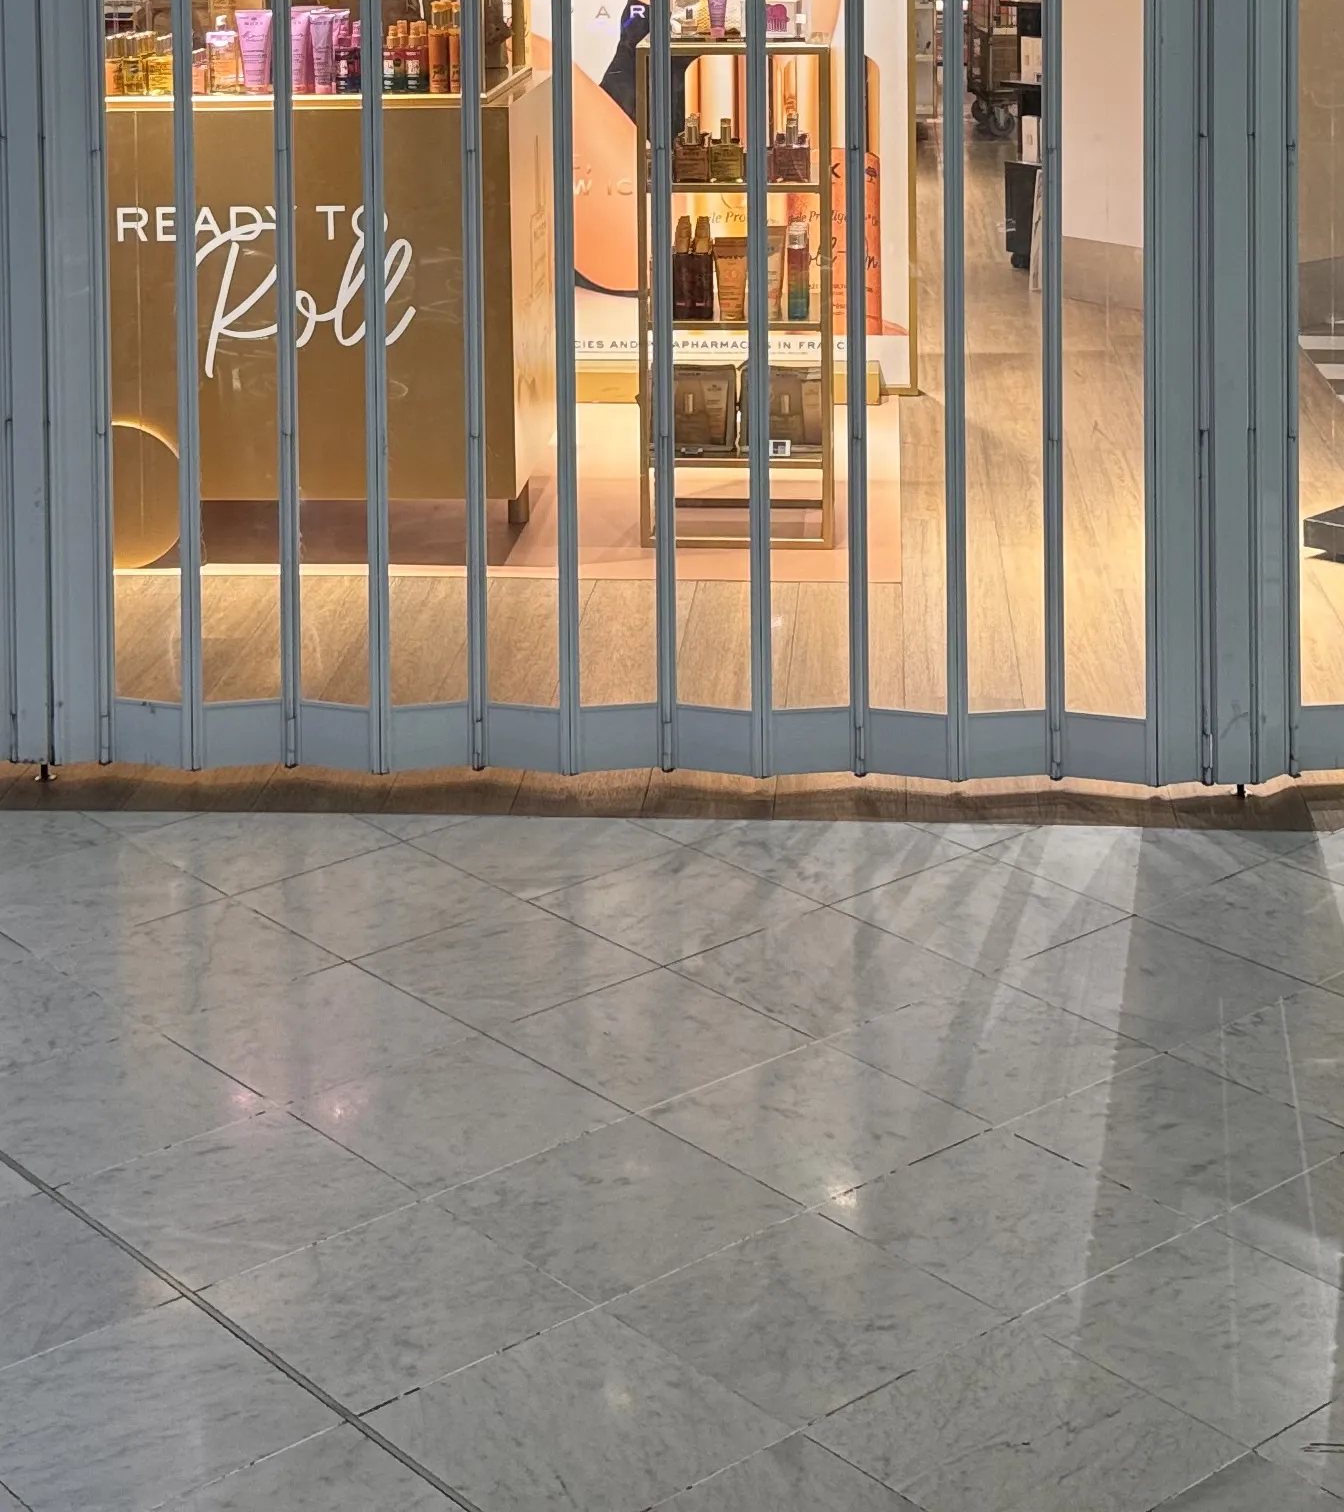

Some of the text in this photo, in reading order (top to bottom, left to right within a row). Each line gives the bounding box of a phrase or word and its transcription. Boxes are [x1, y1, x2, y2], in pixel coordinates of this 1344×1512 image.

[315, 204, 389, 241] TO
[195, 222, 418, 379] Roll
[609, 340, 638, 350] AND
